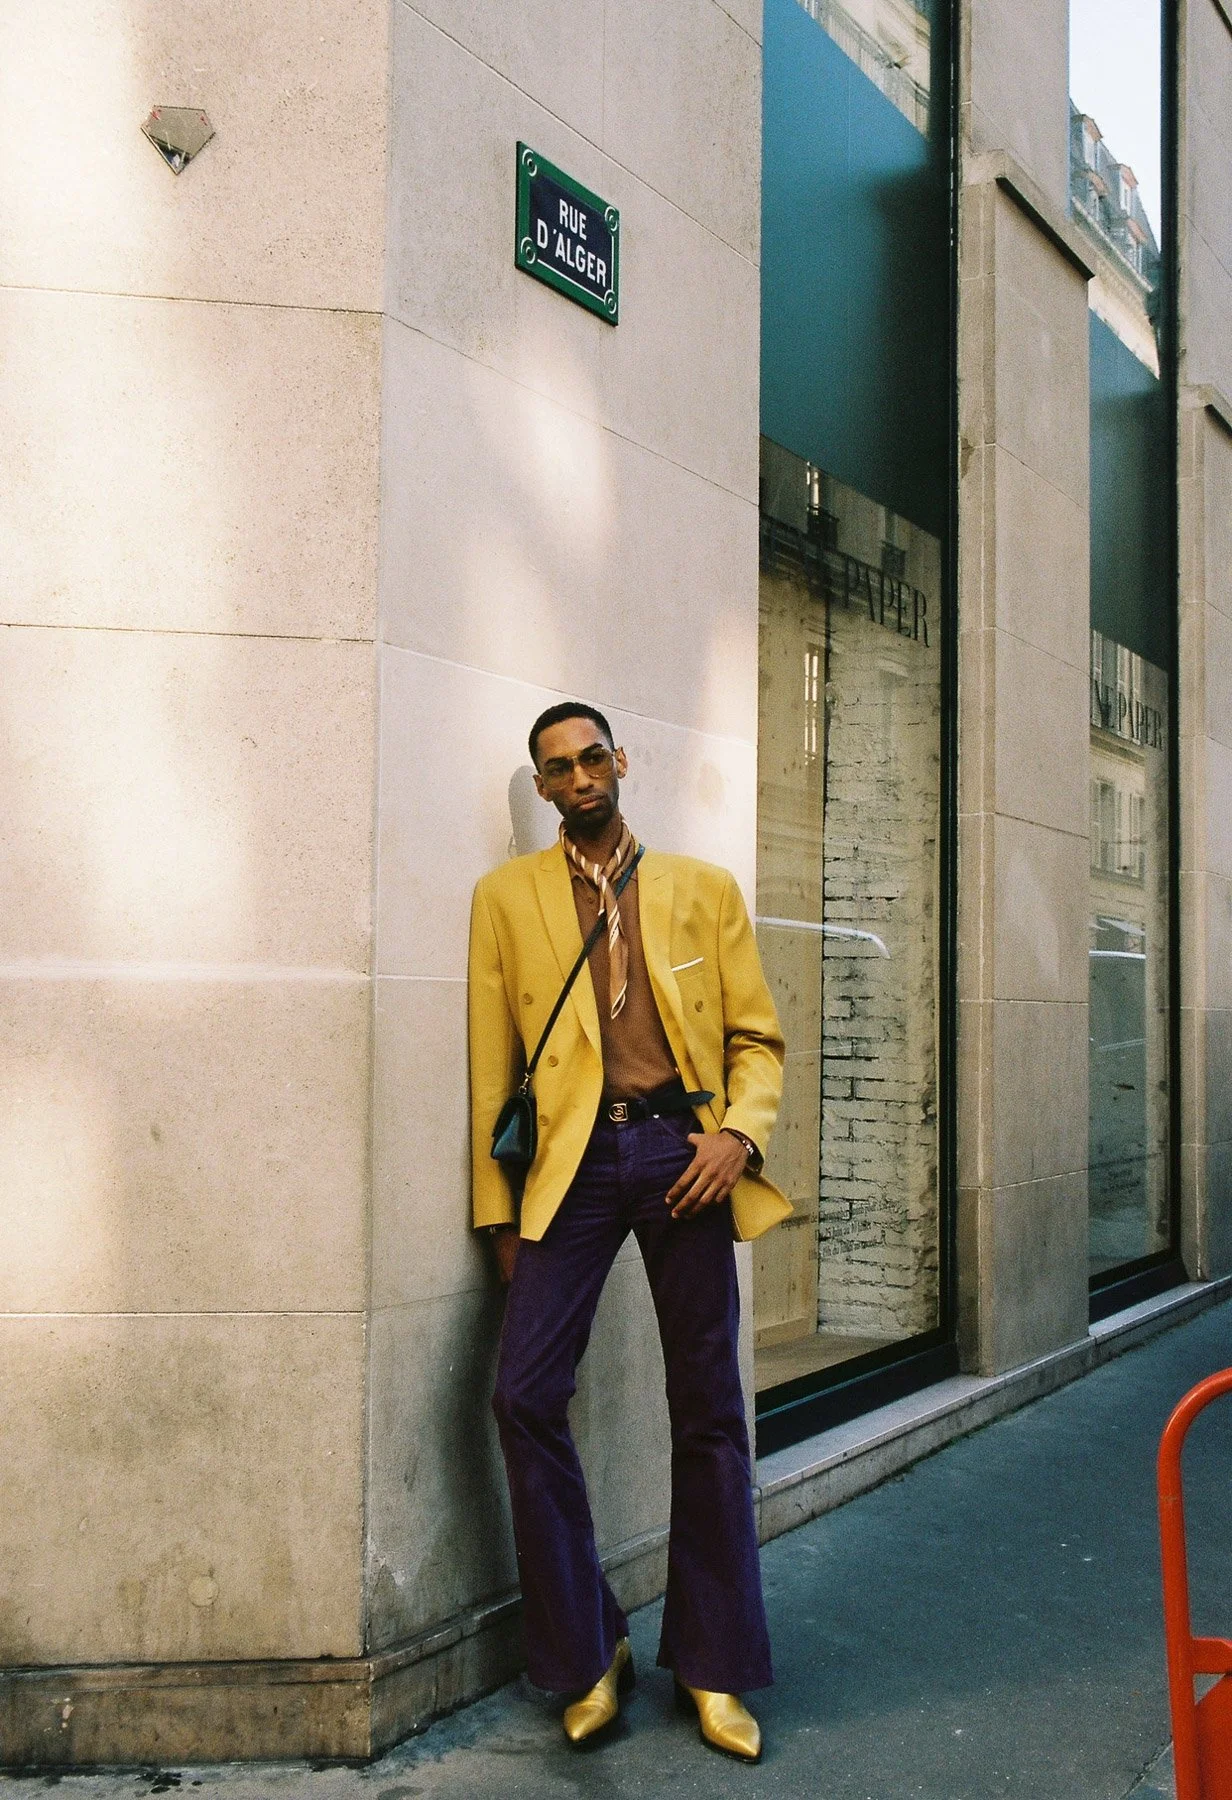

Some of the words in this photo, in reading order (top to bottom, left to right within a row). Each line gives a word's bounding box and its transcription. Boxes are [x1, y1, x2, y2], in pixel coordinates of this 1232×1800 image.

[559, 199, 587, 240] RUE
[537, 218, 606, 287] D'ALGER
[845, 550, 930, 648] PAPER
[1118, 691, 1164, 751] PAPER
